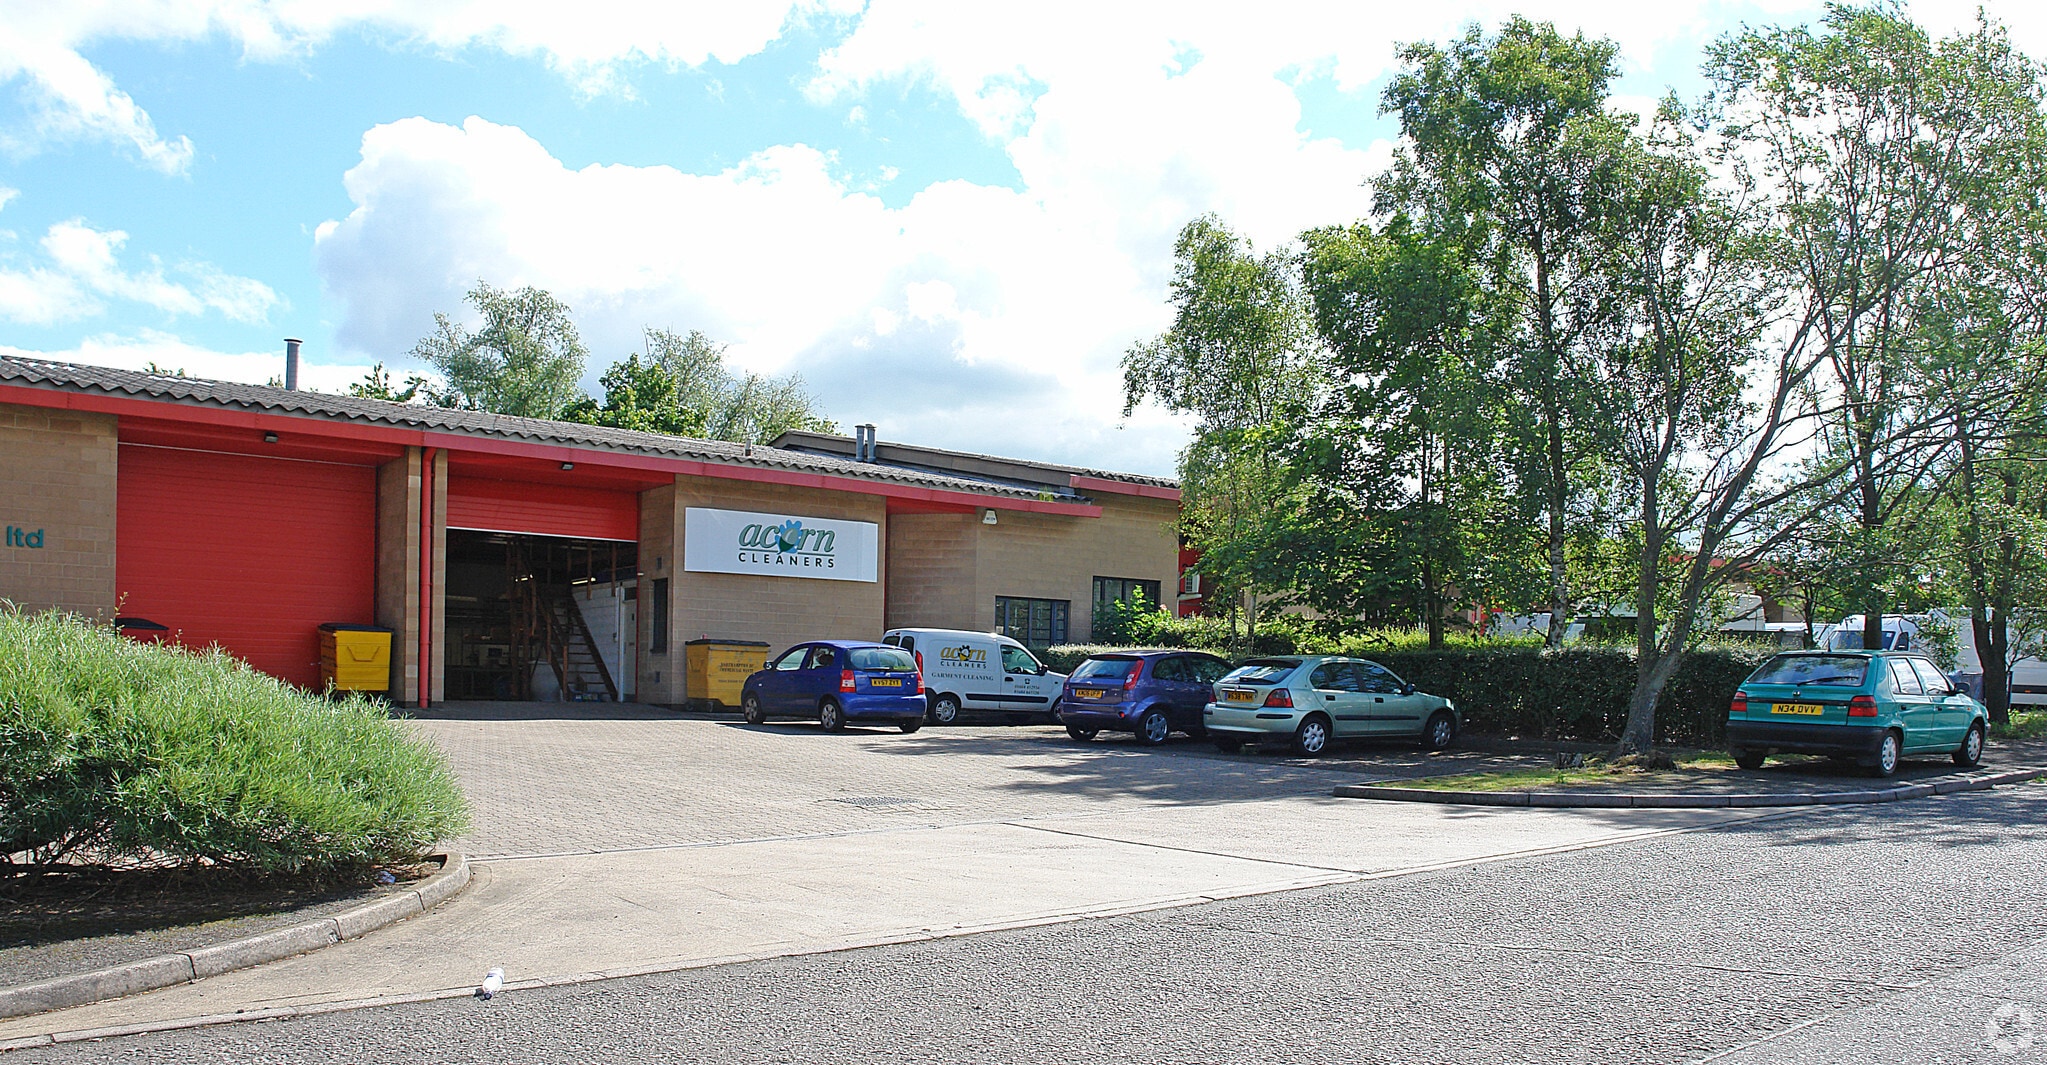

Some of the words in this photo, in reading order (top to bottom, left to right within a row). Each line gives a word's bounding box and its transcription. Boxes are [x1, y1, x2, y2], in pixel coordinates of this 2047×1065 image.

[6, 525, 45, 549] ltd
[738, 522, 836, 553] acorn
[738, 552, 835, 569] CLEANERS
[940, 646, 987, 661] acorn
[940, 661, 987, 669] CLEANERS
[931, 672, 961, 680] GARMENT
[963, 673, 994, 681] CLEANING
[1777, 704, 1795, 713] N34
[1797, 705, 1817, 714] DVV
